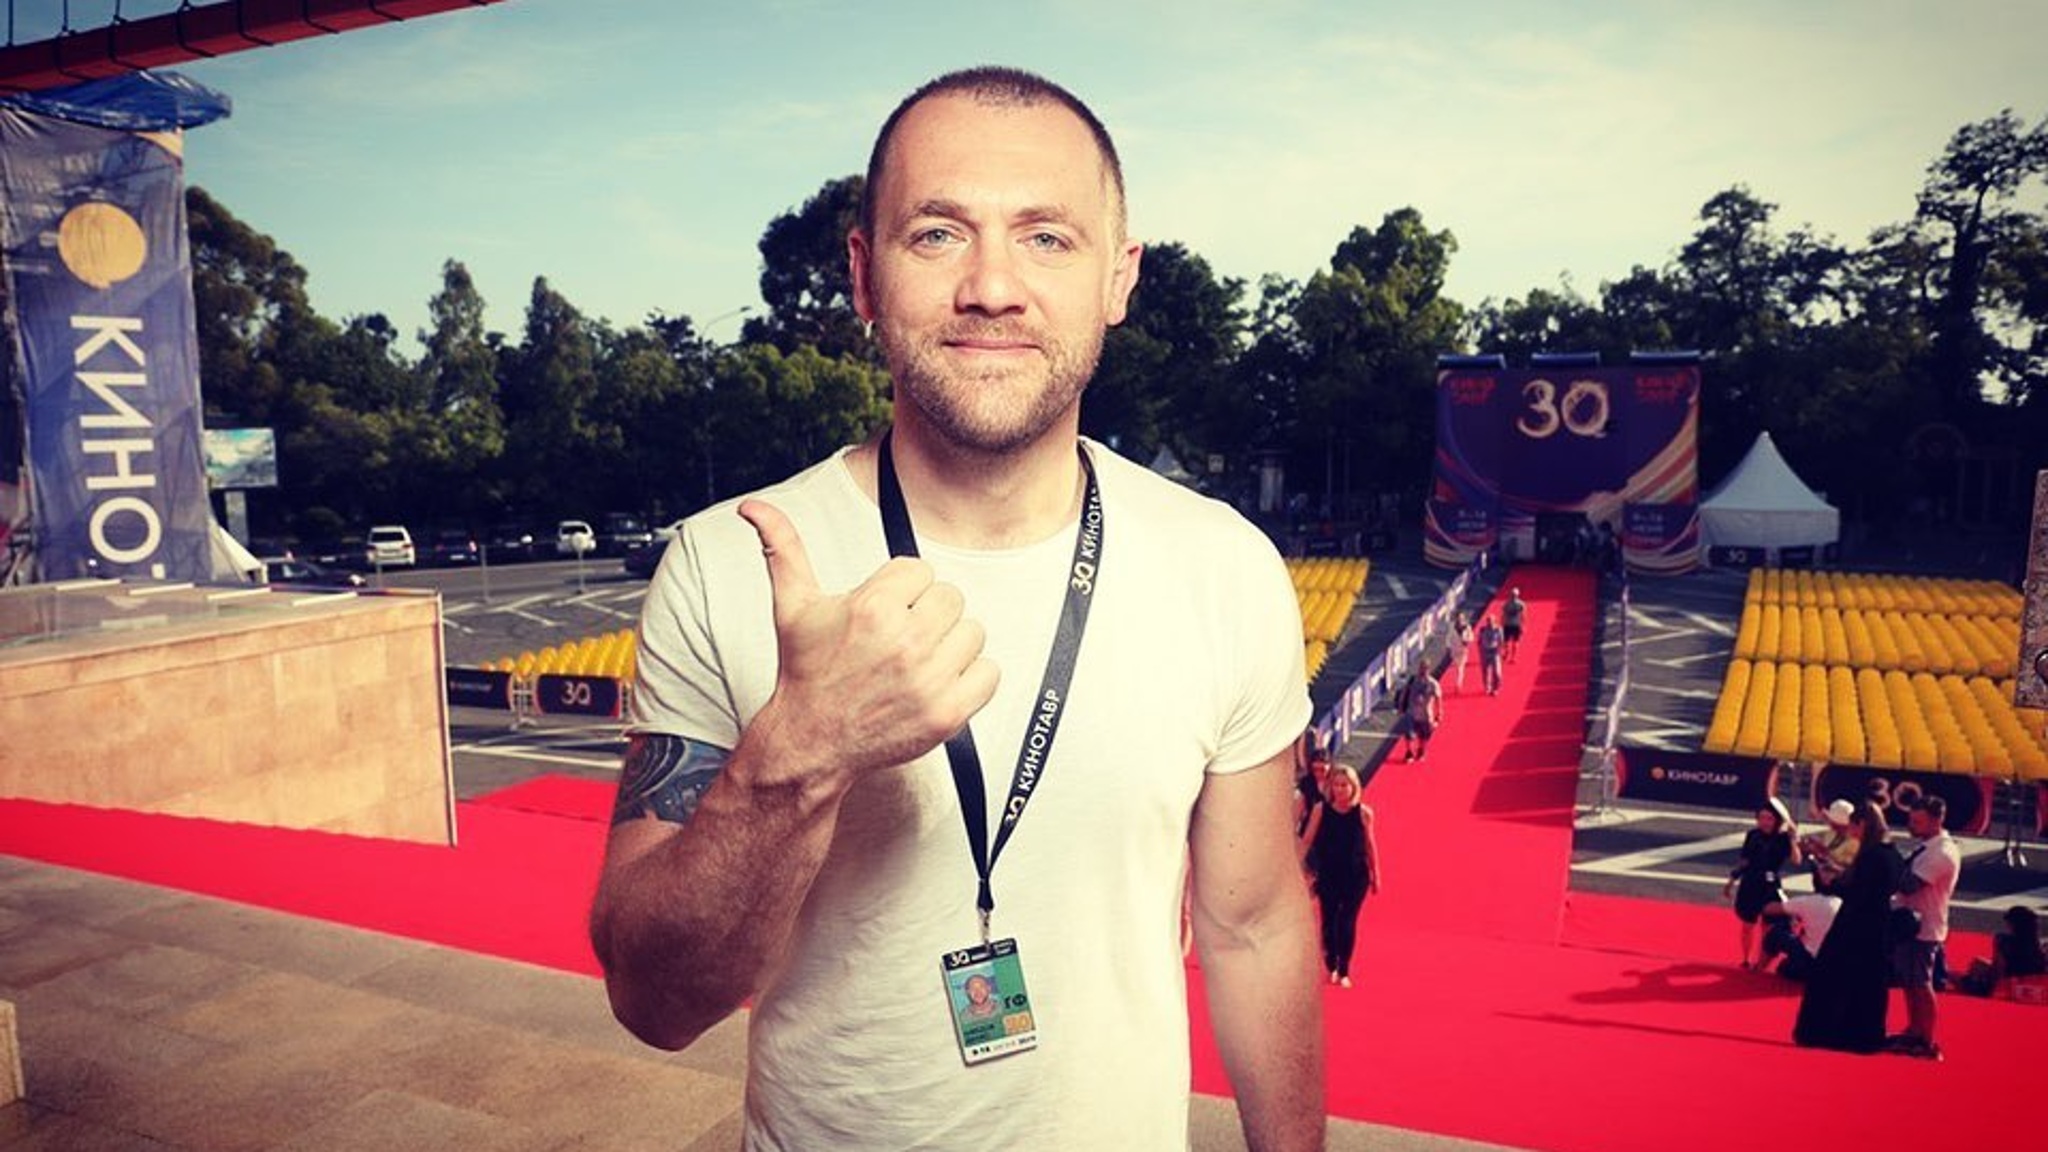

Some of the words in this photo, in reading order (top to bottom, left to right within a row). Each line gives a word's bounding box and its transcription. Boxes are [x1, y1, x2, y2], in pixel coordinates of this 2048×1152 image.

[70, 314, 165, 579] КИНО
[1071, 561, 1096, 596] 30
[1018, 689, 1060, 792] КИНОТАВР
